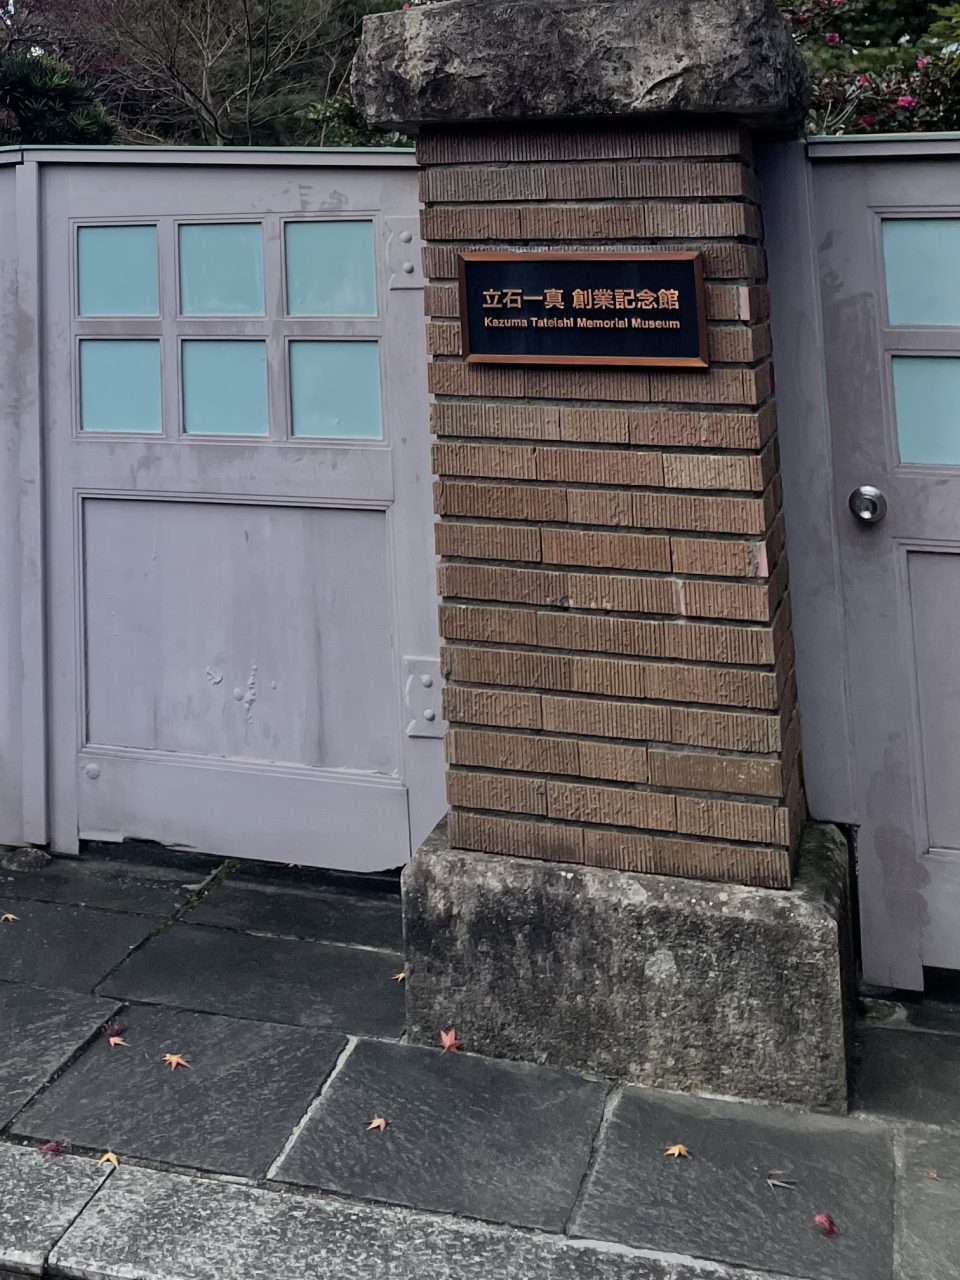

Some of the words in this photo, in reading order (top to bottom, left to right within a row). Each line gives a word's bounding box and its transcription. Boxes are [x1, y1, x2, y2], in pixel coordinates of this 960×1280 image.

[482, 288, 565, 309] 立石一真
[571, 288, 679, 310] 創業記念館
[484, 317, 528, 327] Kazuma
[530, 317, 574, 328] Tateishi
[576, 317, 628, 328] Memorial
[631, 317, 681, 329] Museum
